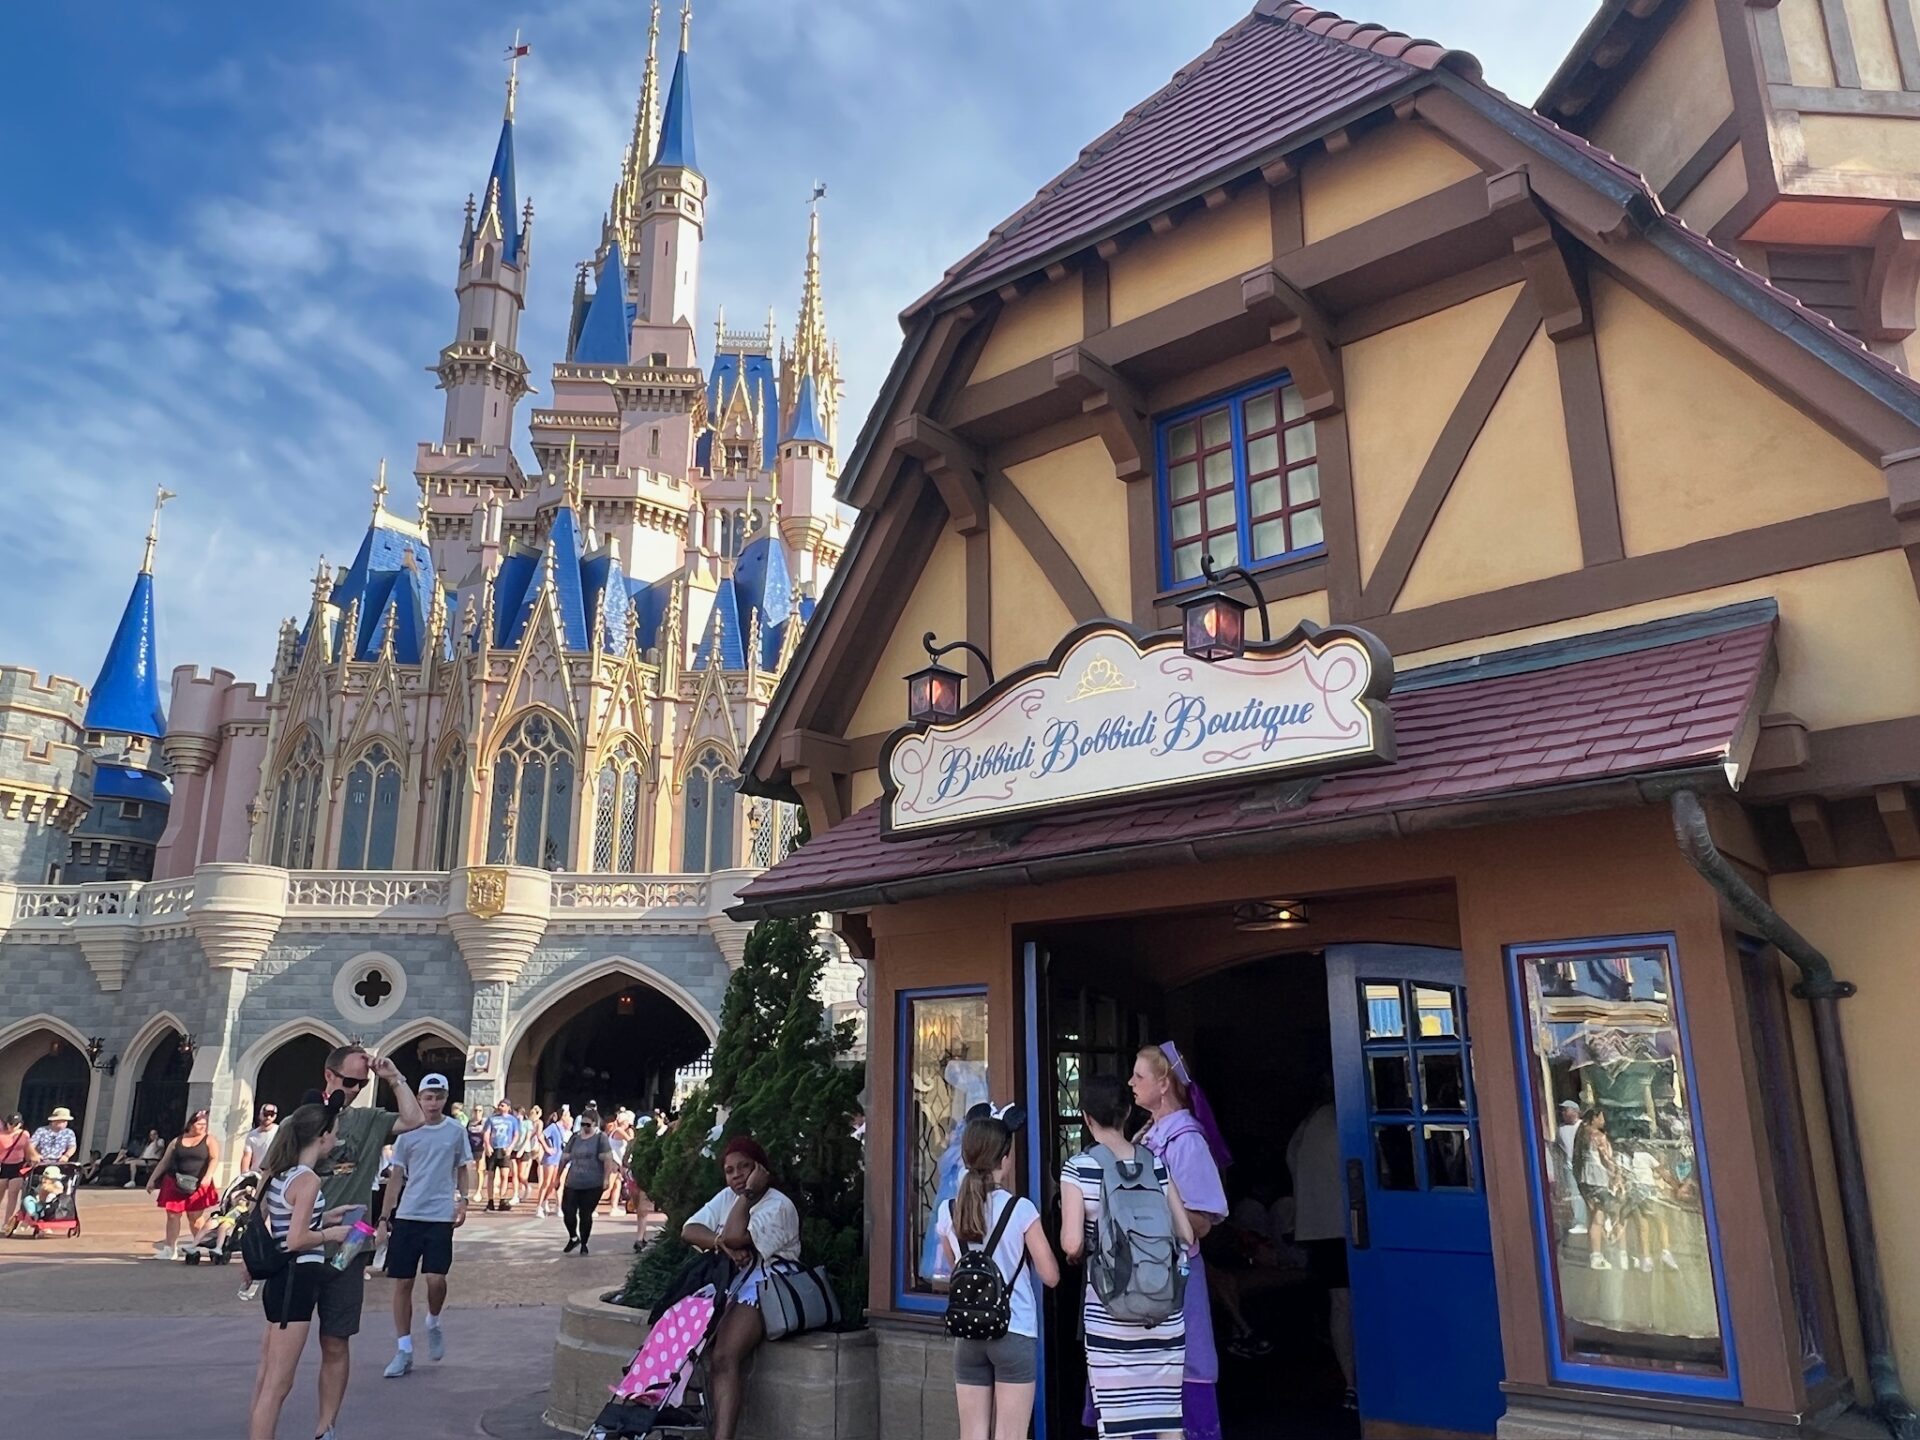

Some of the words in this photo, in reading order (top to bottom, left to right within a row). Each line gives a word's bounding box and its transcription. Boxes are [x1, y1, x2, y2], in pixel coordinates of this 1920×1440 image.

[927, 736, 1035, 804] Bibbidi
[1030, 710, 1157, 779] Bobbidi
[1150, 692, 1315, 756] Boutique
